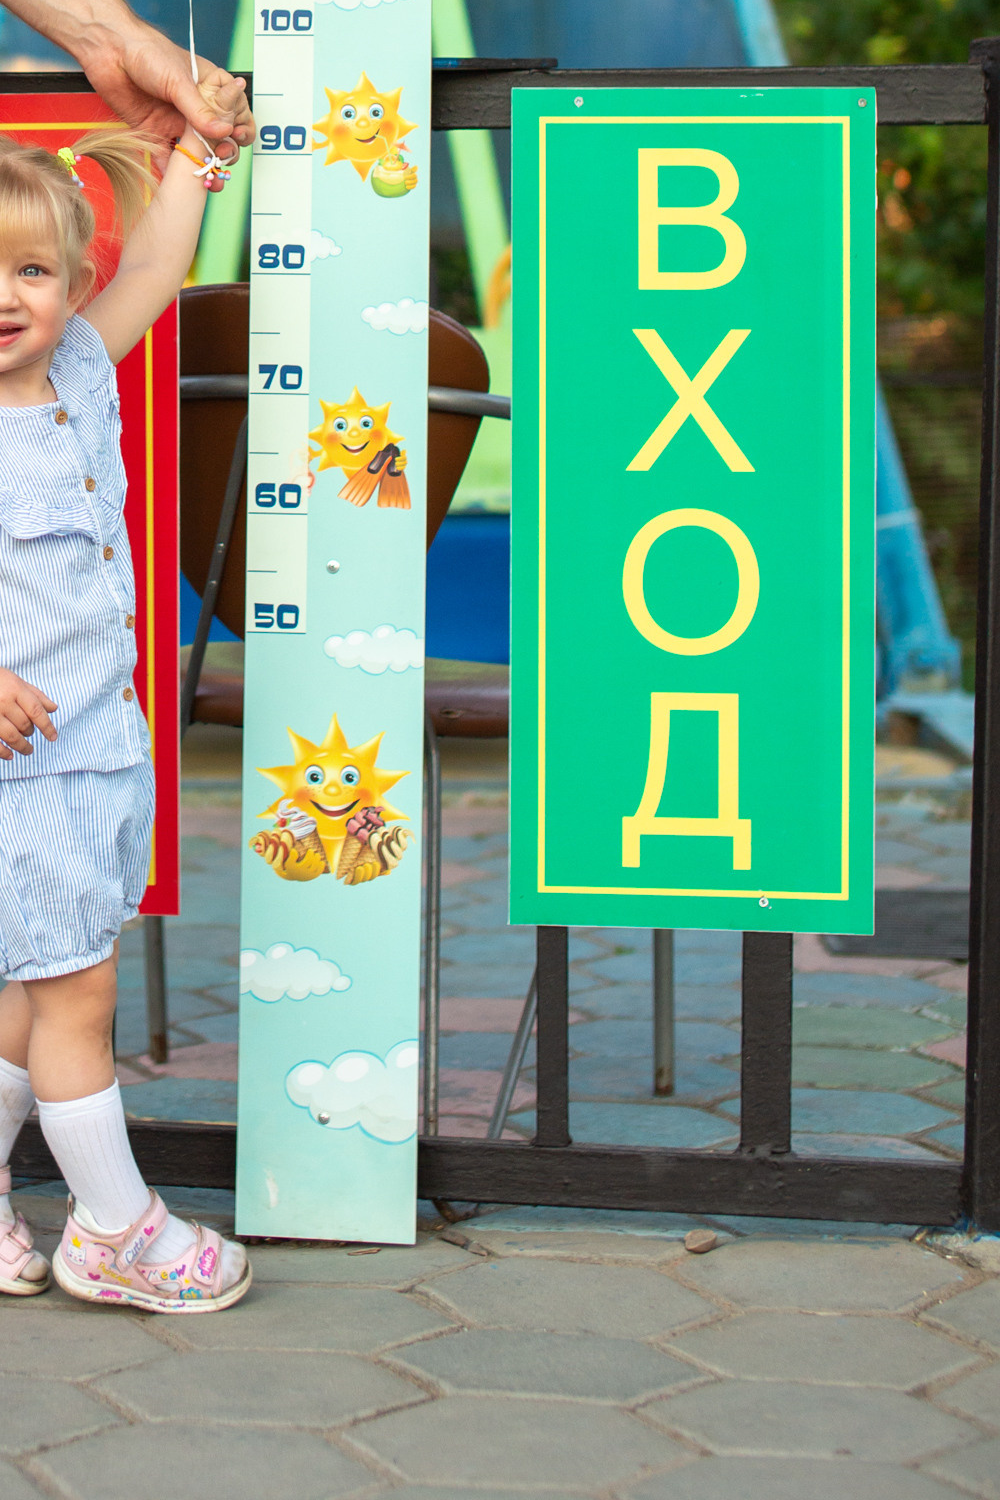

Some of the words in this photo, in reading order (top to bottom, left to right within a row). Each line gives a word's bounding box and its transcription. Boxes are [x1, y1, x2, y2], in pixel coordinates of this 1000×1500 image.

[260, 9, 313, 32] 100
[259, 125, 307, 152] 90
[257, 243, 305, 269] 80
[258, 364, 304, 390] 70
[254, 482, 302, 508] 60
[621, 147, 761, 871] ВХОД
[254, 603, 300, 630] 50
[125, 1236, 145, 1265] Cute
